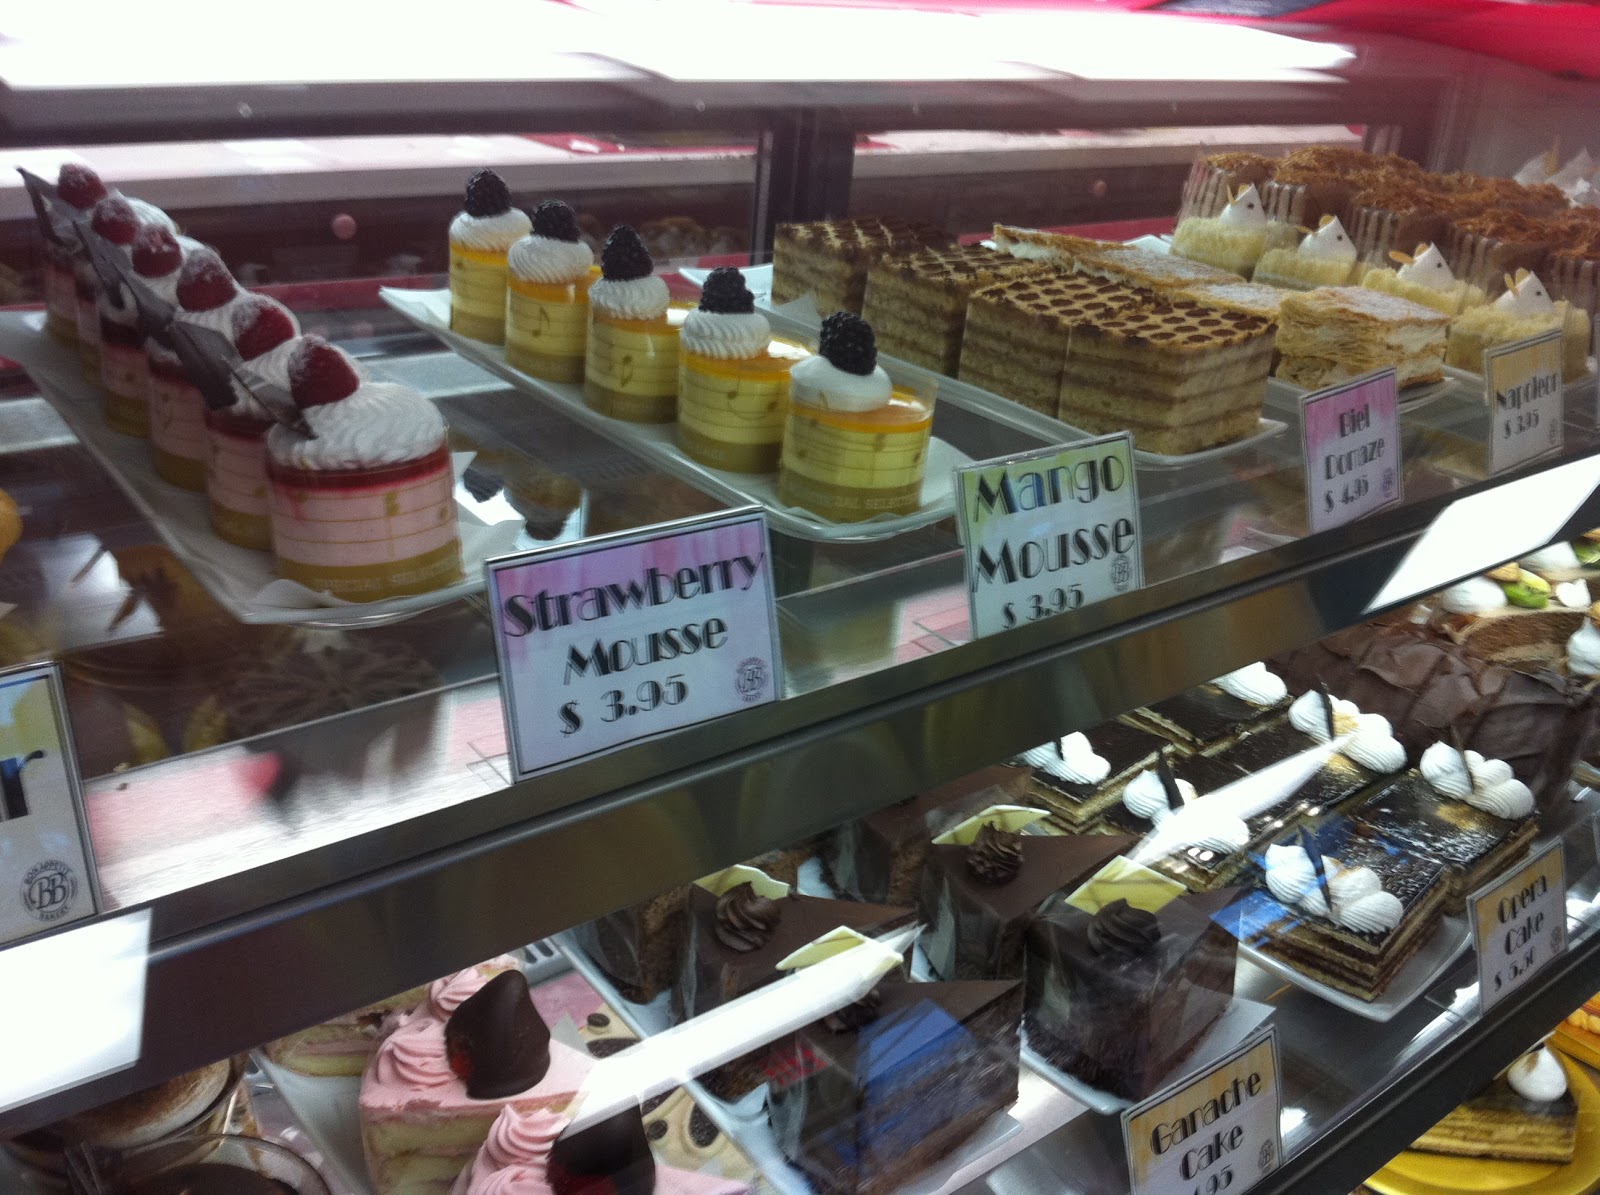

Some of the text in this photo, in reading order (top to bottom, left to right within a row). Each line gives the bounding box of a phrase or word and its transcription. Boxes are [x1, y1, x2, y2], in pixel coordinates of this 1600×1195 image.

[1515, 408, 1539, 435] 3.95
[973, 455, 1125, 522] Mango
[1323, 490, 1335, 513] $
[1340, 474, 1370, 505] 4.95
[972, 518, 1135, 593] Mousse
[504, 551, 764, 637] Strawberry
[1001, 583, 1085, 629] $ 3.95
[563, 617, 728, 686] Mousse
[559, 674, 689, 738] $ 3.95
[28, 872, 67, 910] BB
[1497, 875, 1548, 924] Opera
[1504, 911, 1544, 955] Cake
[1494, 970, 1502, 993] $
[1150, 1071, 1262, 1156] Ganache
[1179, 1124, 1244, 1181] Cake
